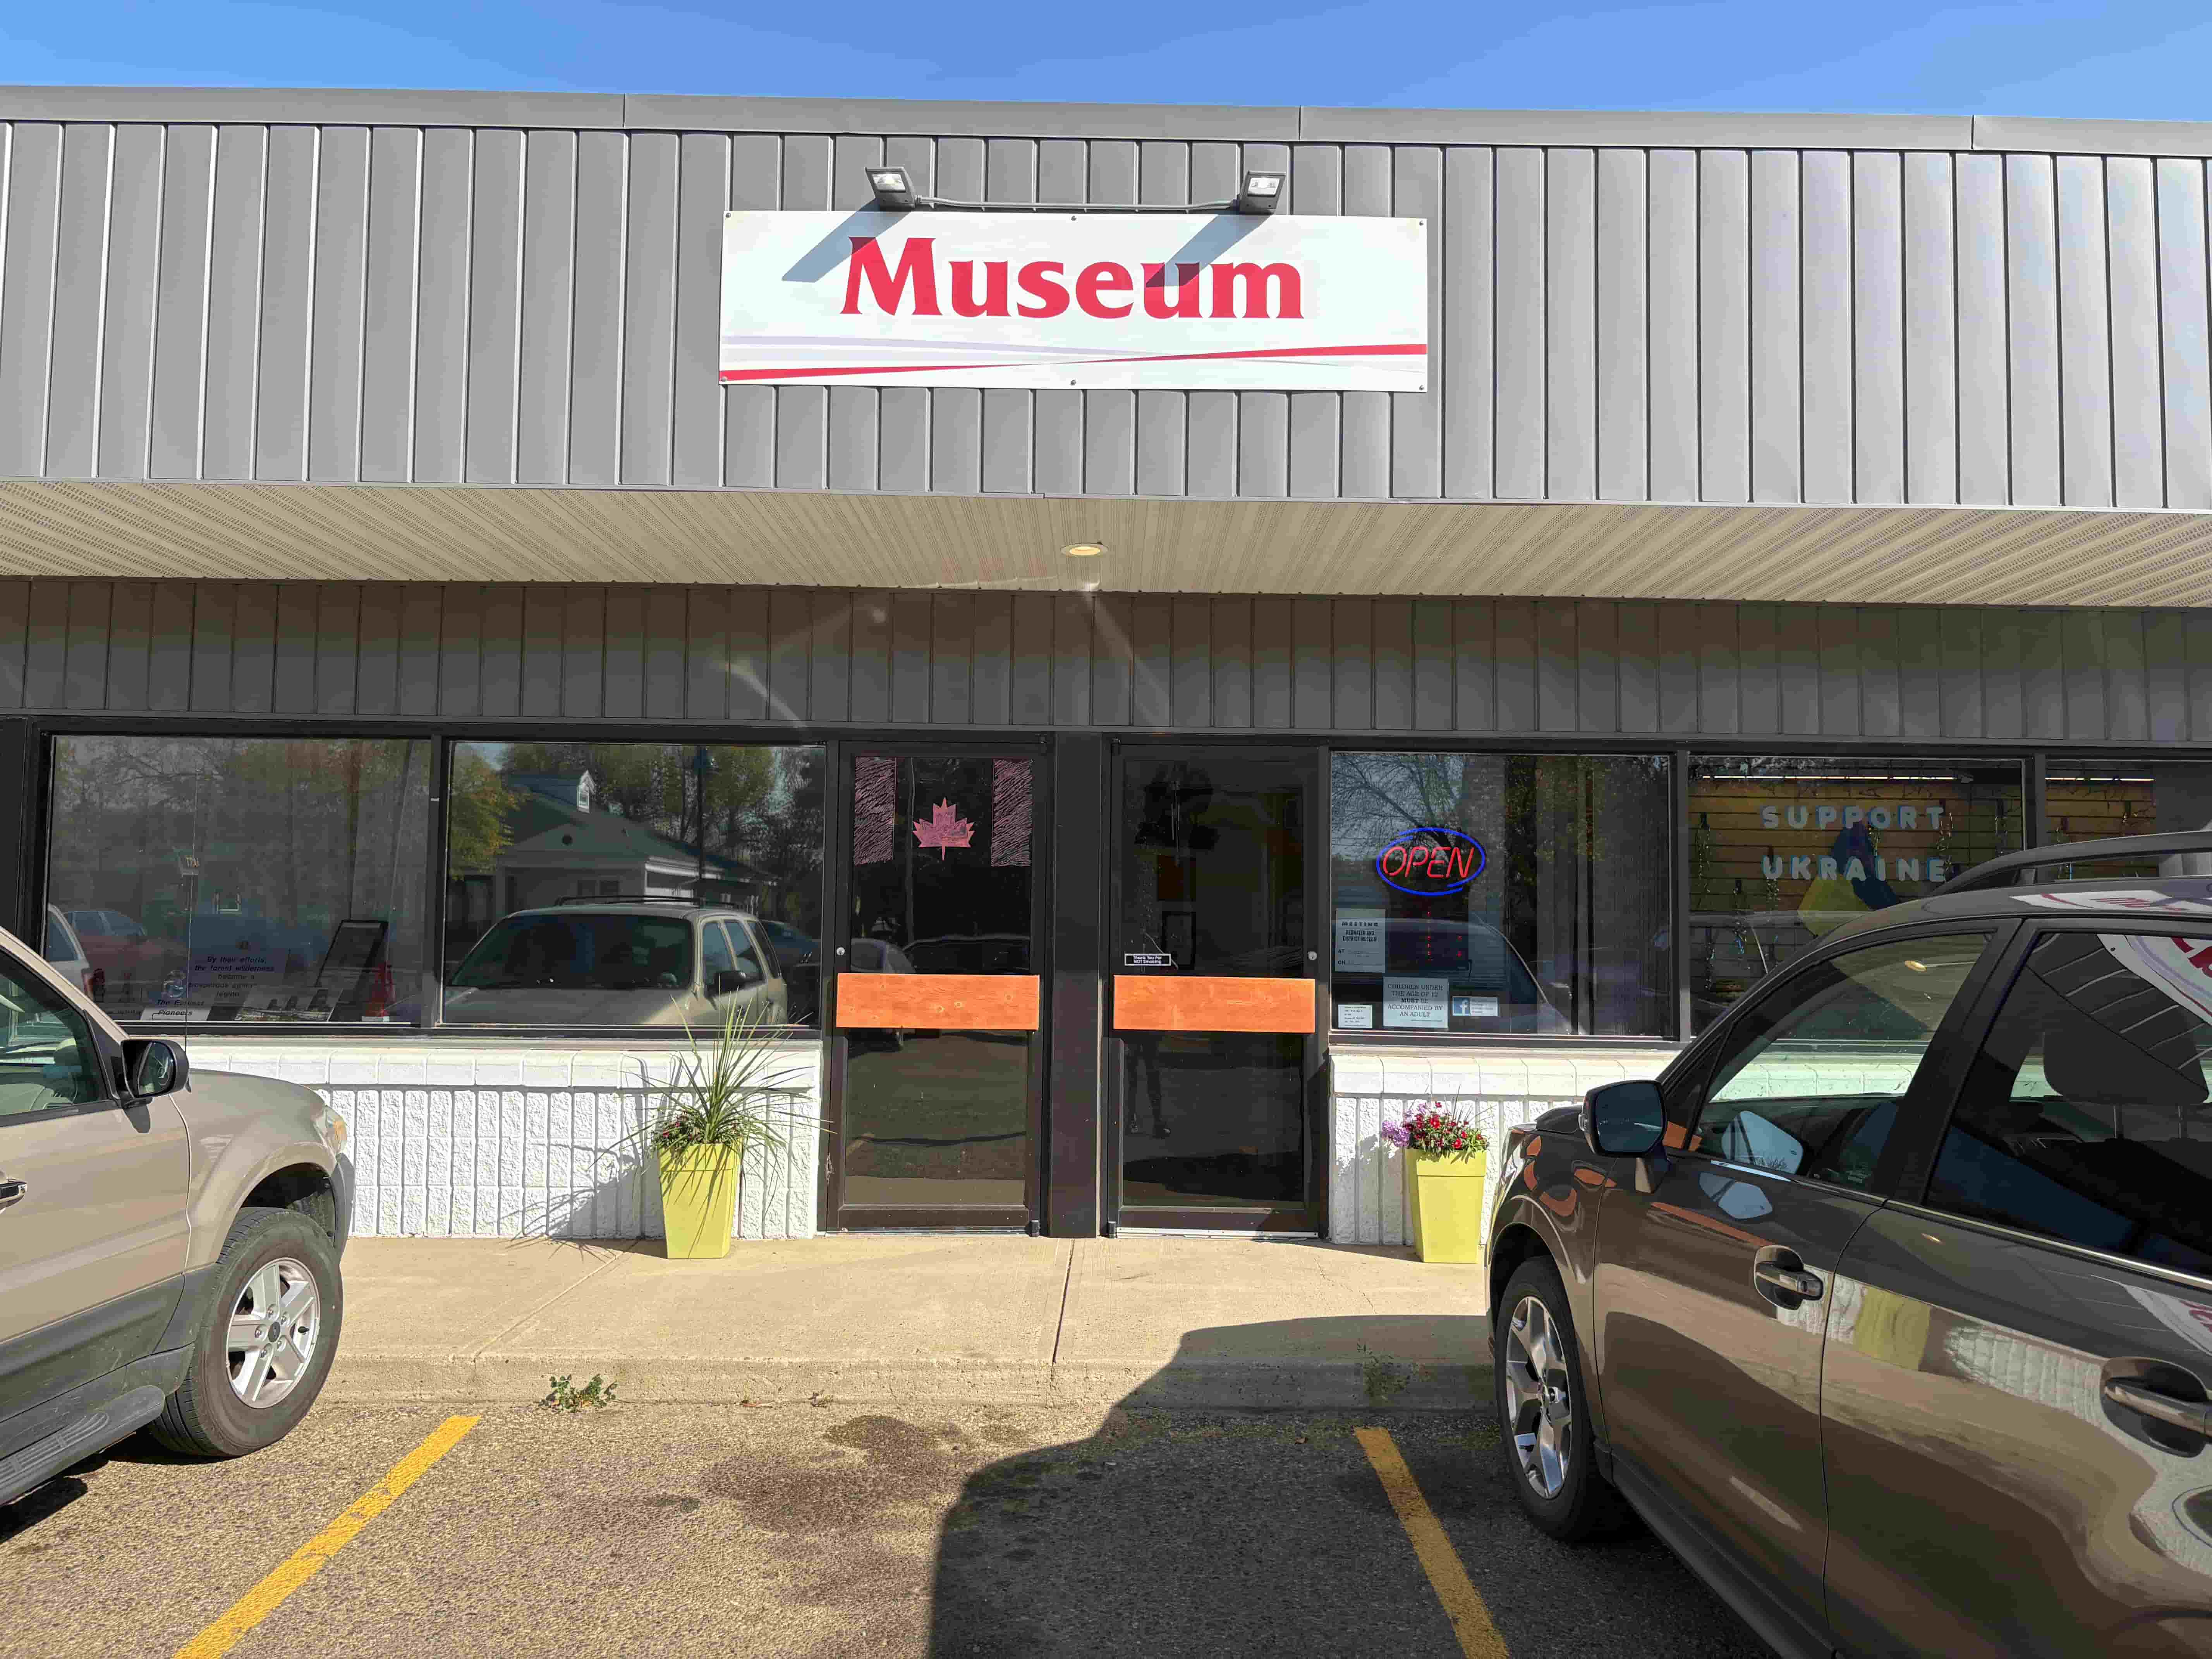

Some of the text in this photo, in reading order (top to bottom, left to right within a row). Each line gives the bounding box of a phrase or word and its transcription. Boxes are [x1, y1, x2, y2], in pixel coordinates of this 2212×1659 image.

[839, 236, 1304, 320] Museum
[1760, 805, 1944, 830] SUPPORT
[1383, 846, 1475, 878] OPEN
[1761, 855, 1946, 882] UKRAINE
